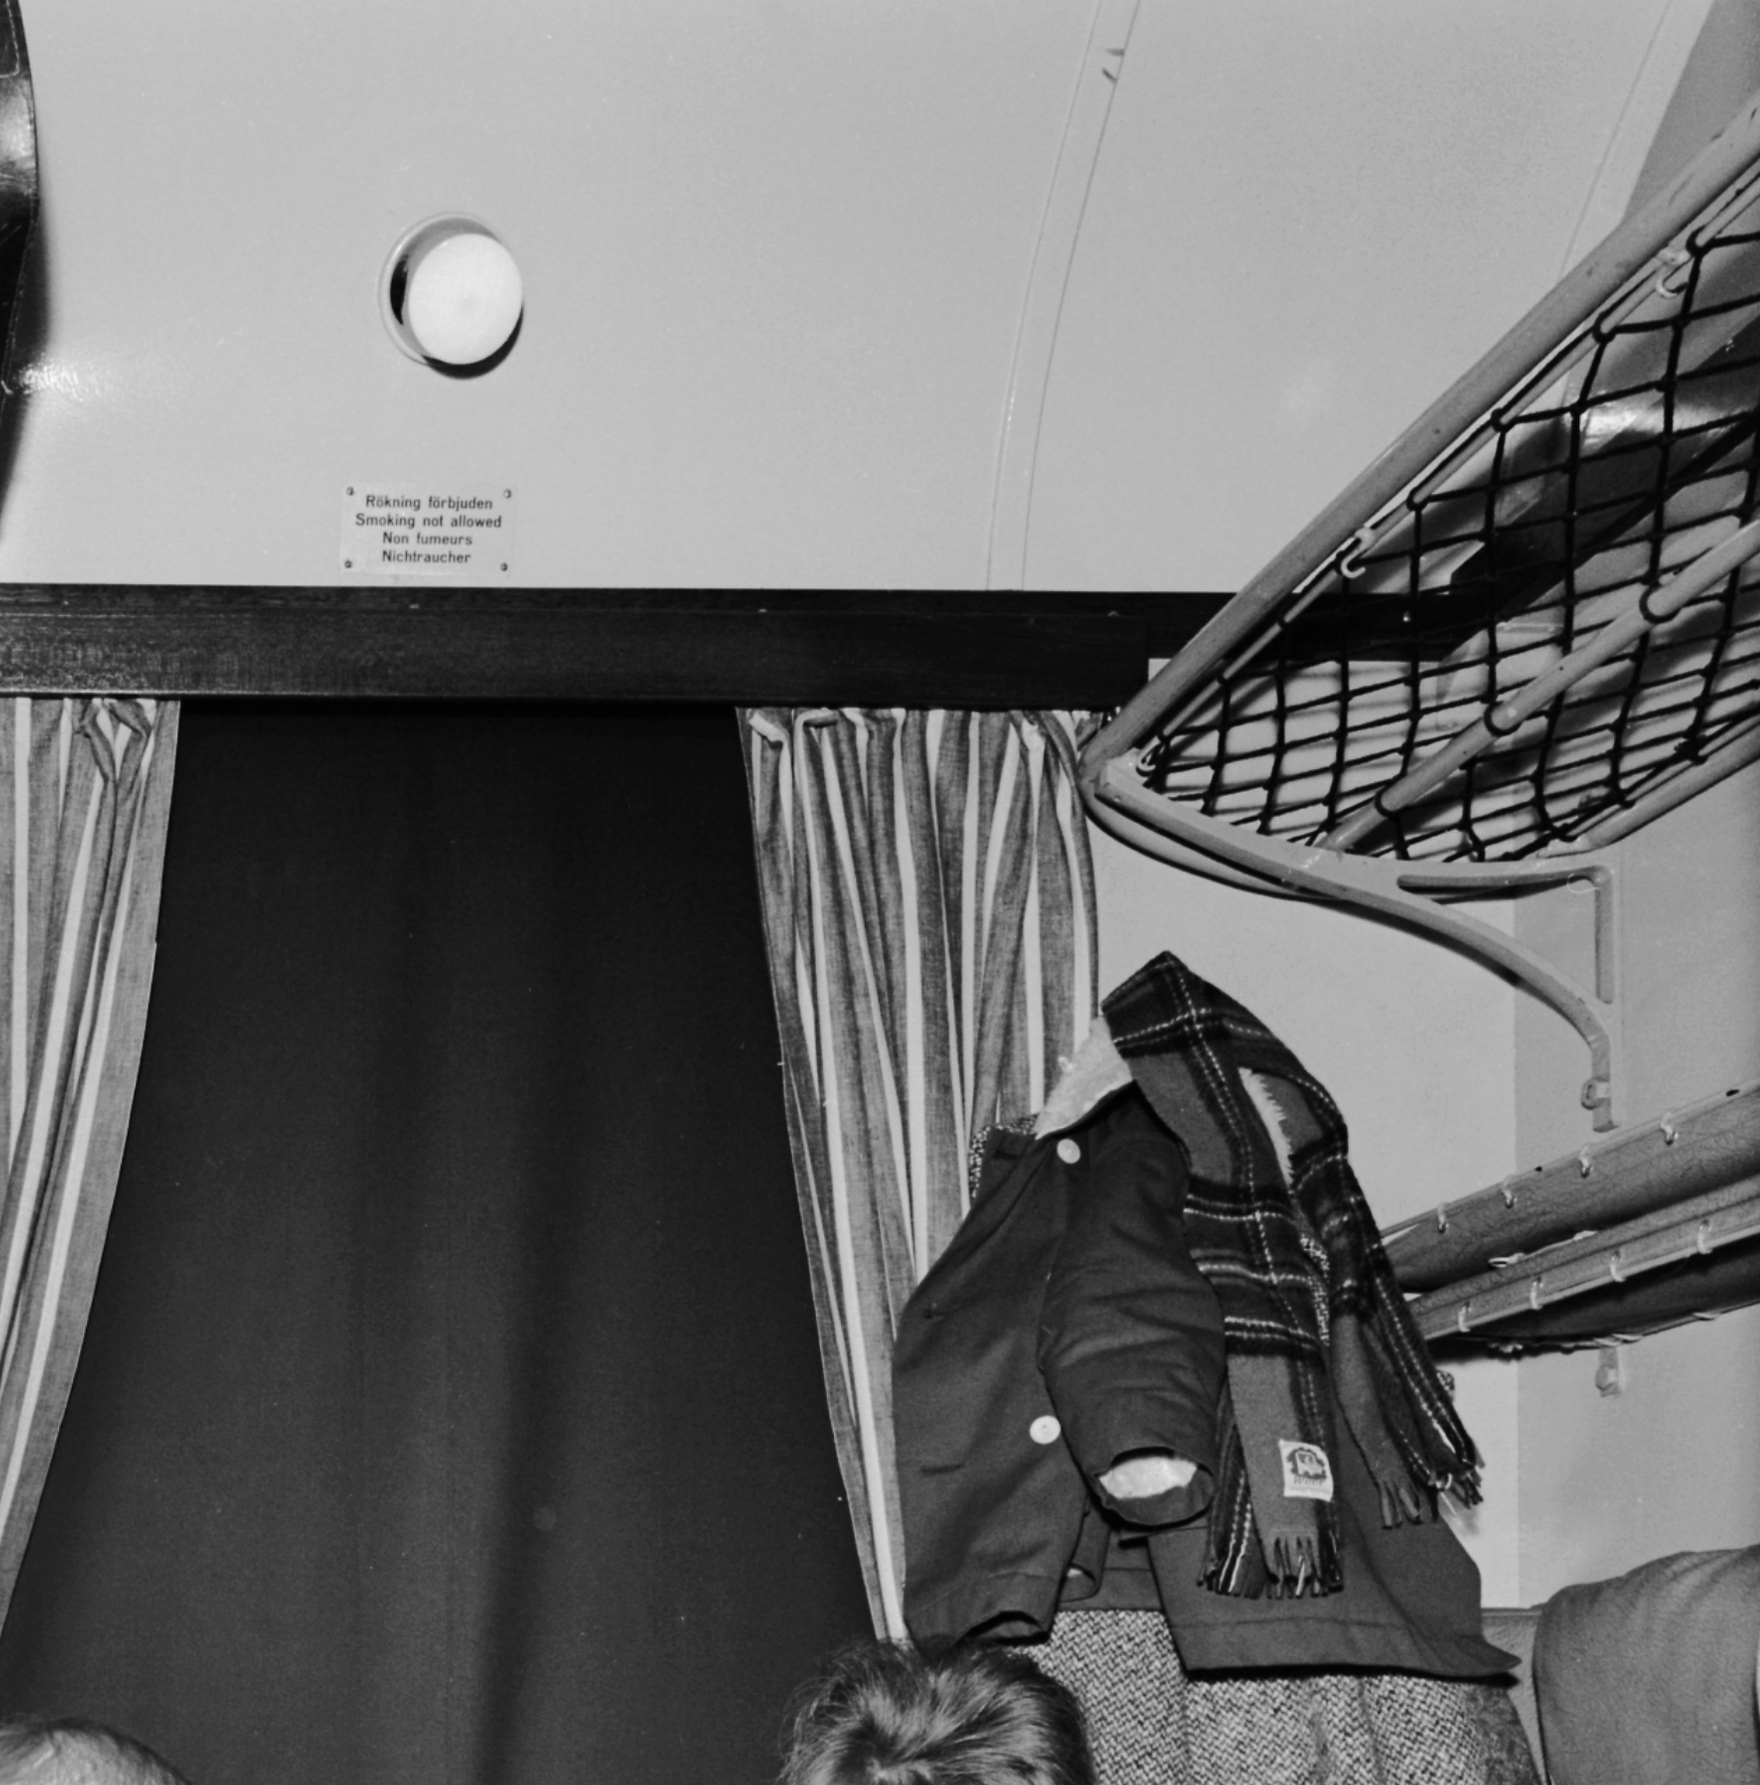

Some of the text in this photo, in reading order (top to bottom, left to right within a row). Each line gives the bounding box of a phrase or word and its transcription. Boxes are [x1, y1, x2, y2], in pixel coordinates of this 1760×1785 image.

[365, 495, 493, 512] Rökning förbjuden
[355, 513, 502, 529] Smoking not allowed
[382, 531, 473, 545] Non fumeurs
[382, 550, 472, 564] Nichtraucher
